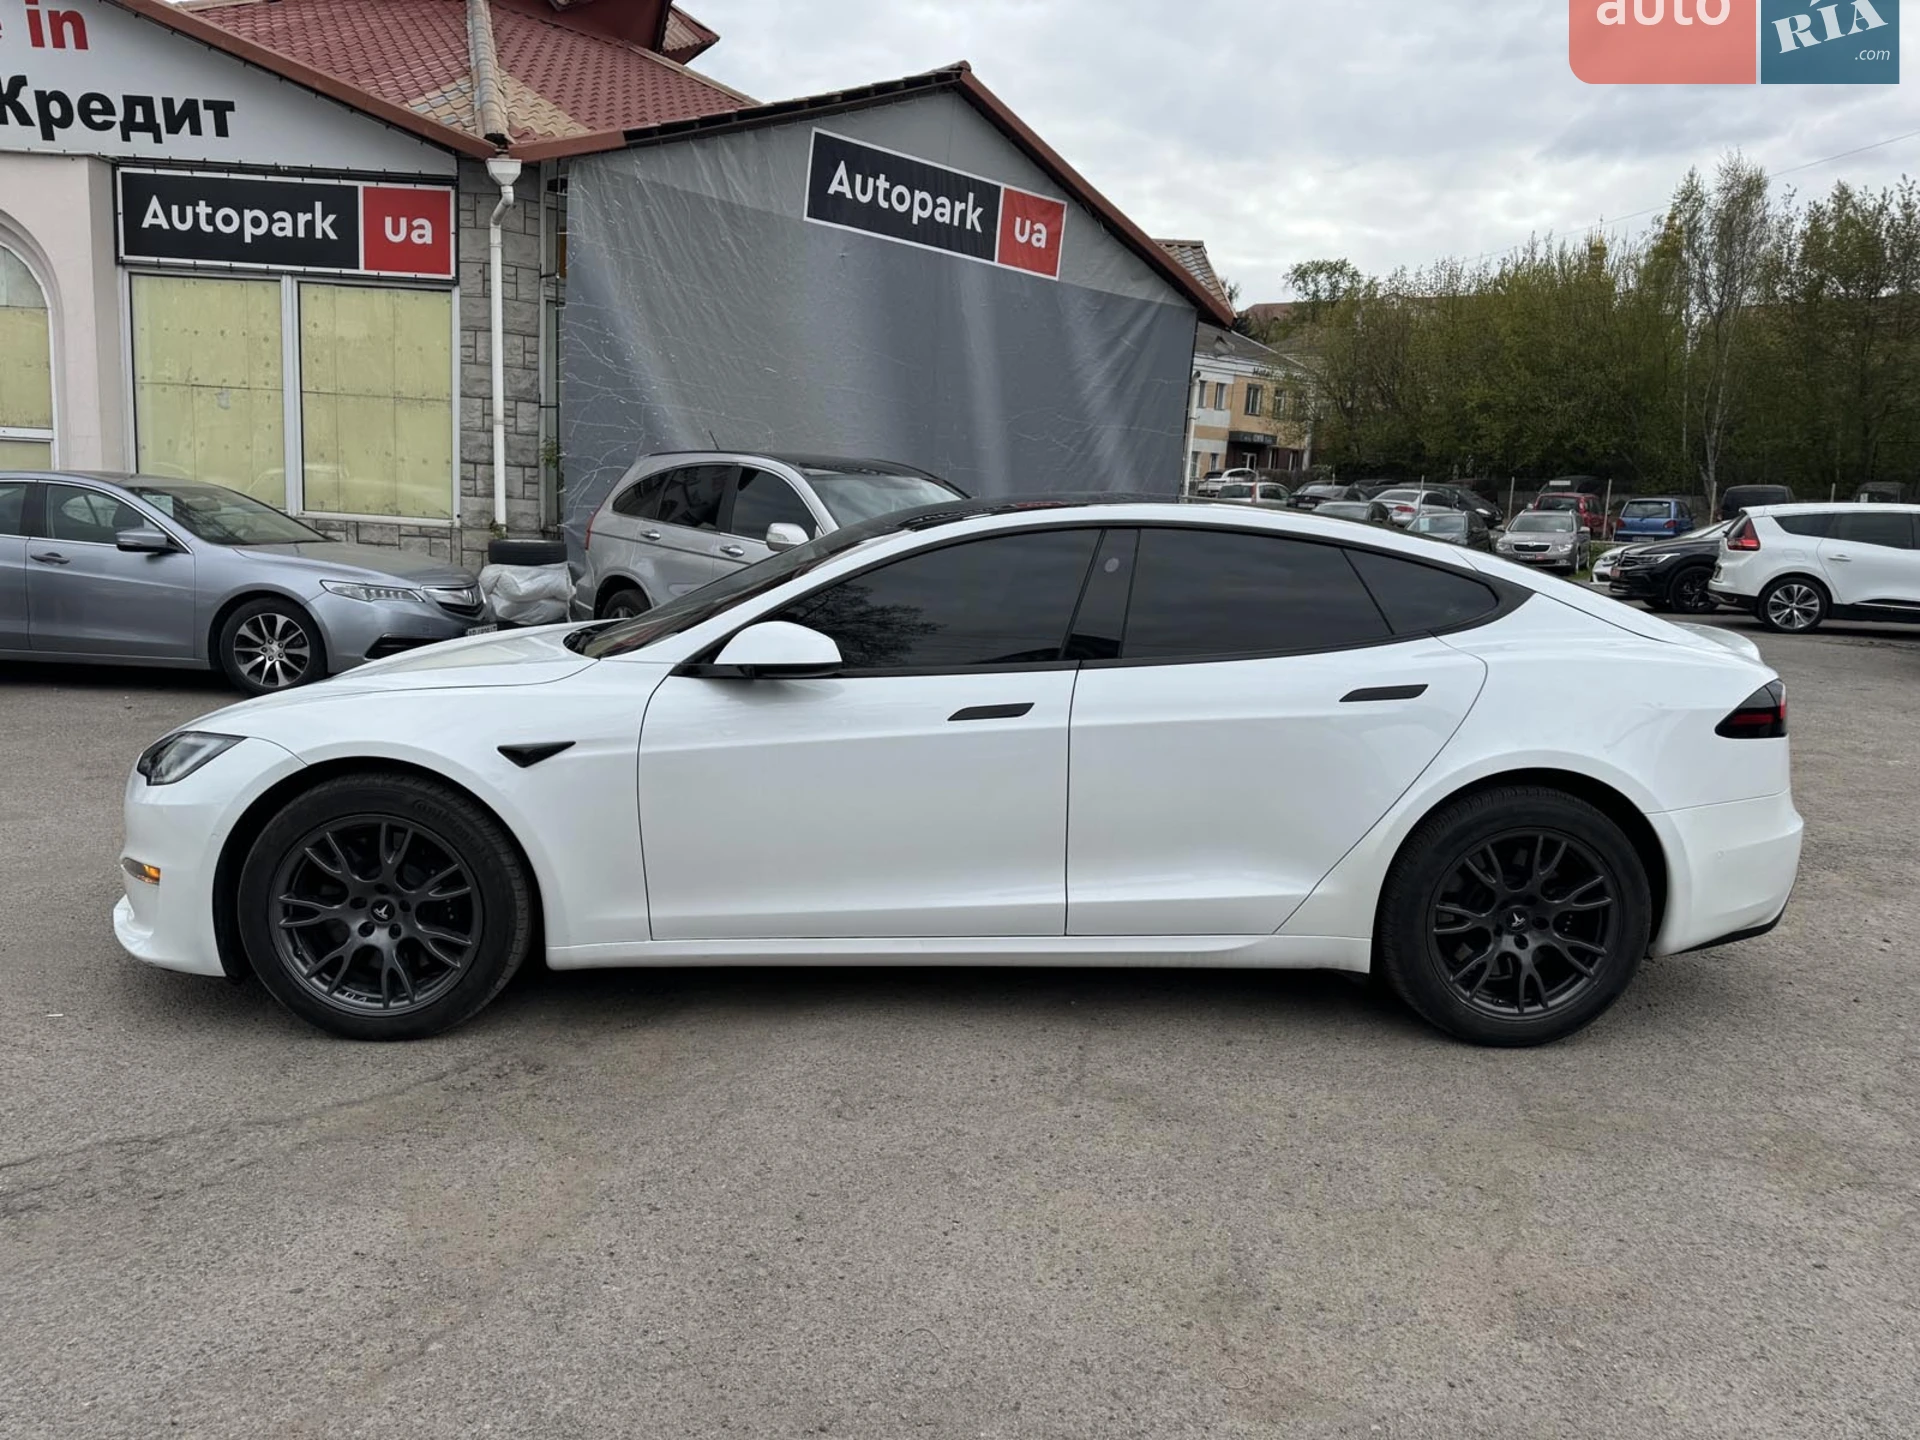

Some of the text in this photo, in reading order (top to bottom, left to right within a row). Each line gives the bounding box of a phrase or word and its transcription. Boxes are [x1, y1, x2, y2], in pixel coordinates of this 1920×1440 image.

[25, 0, 89, 50] in
[0, 75, 235, 144] Кредит
[141, 195, 434, 245] Autopark ua
[827, 160, 1047, 249] Autopark ua
